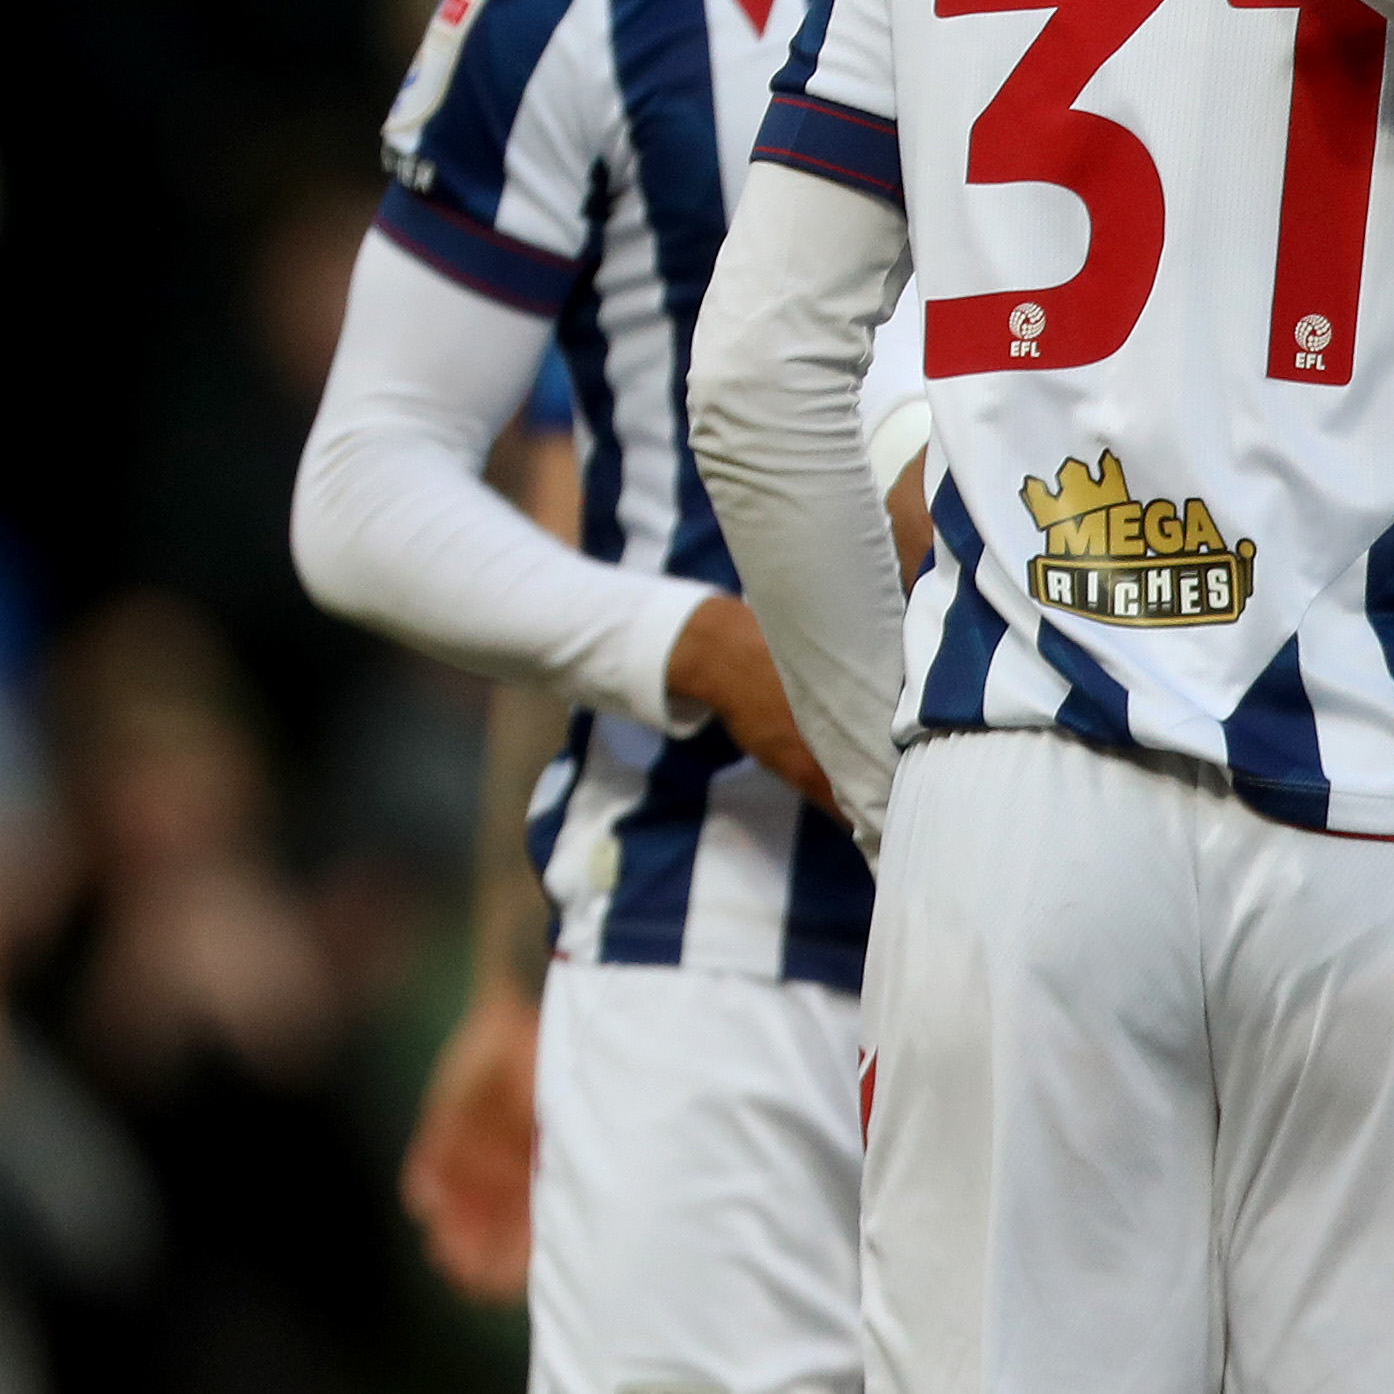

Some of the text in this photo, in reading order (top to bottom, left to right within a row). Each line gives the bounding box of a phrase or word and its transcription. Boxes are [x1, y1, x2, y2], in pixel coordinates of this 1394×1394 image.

[1009, 341, 1040, 358] EFL
[1294, 352, 1326, 371] EFL
[1046, 497, 1227, 556] MEGA
[1047, 567, 1230, 616] RICHES
